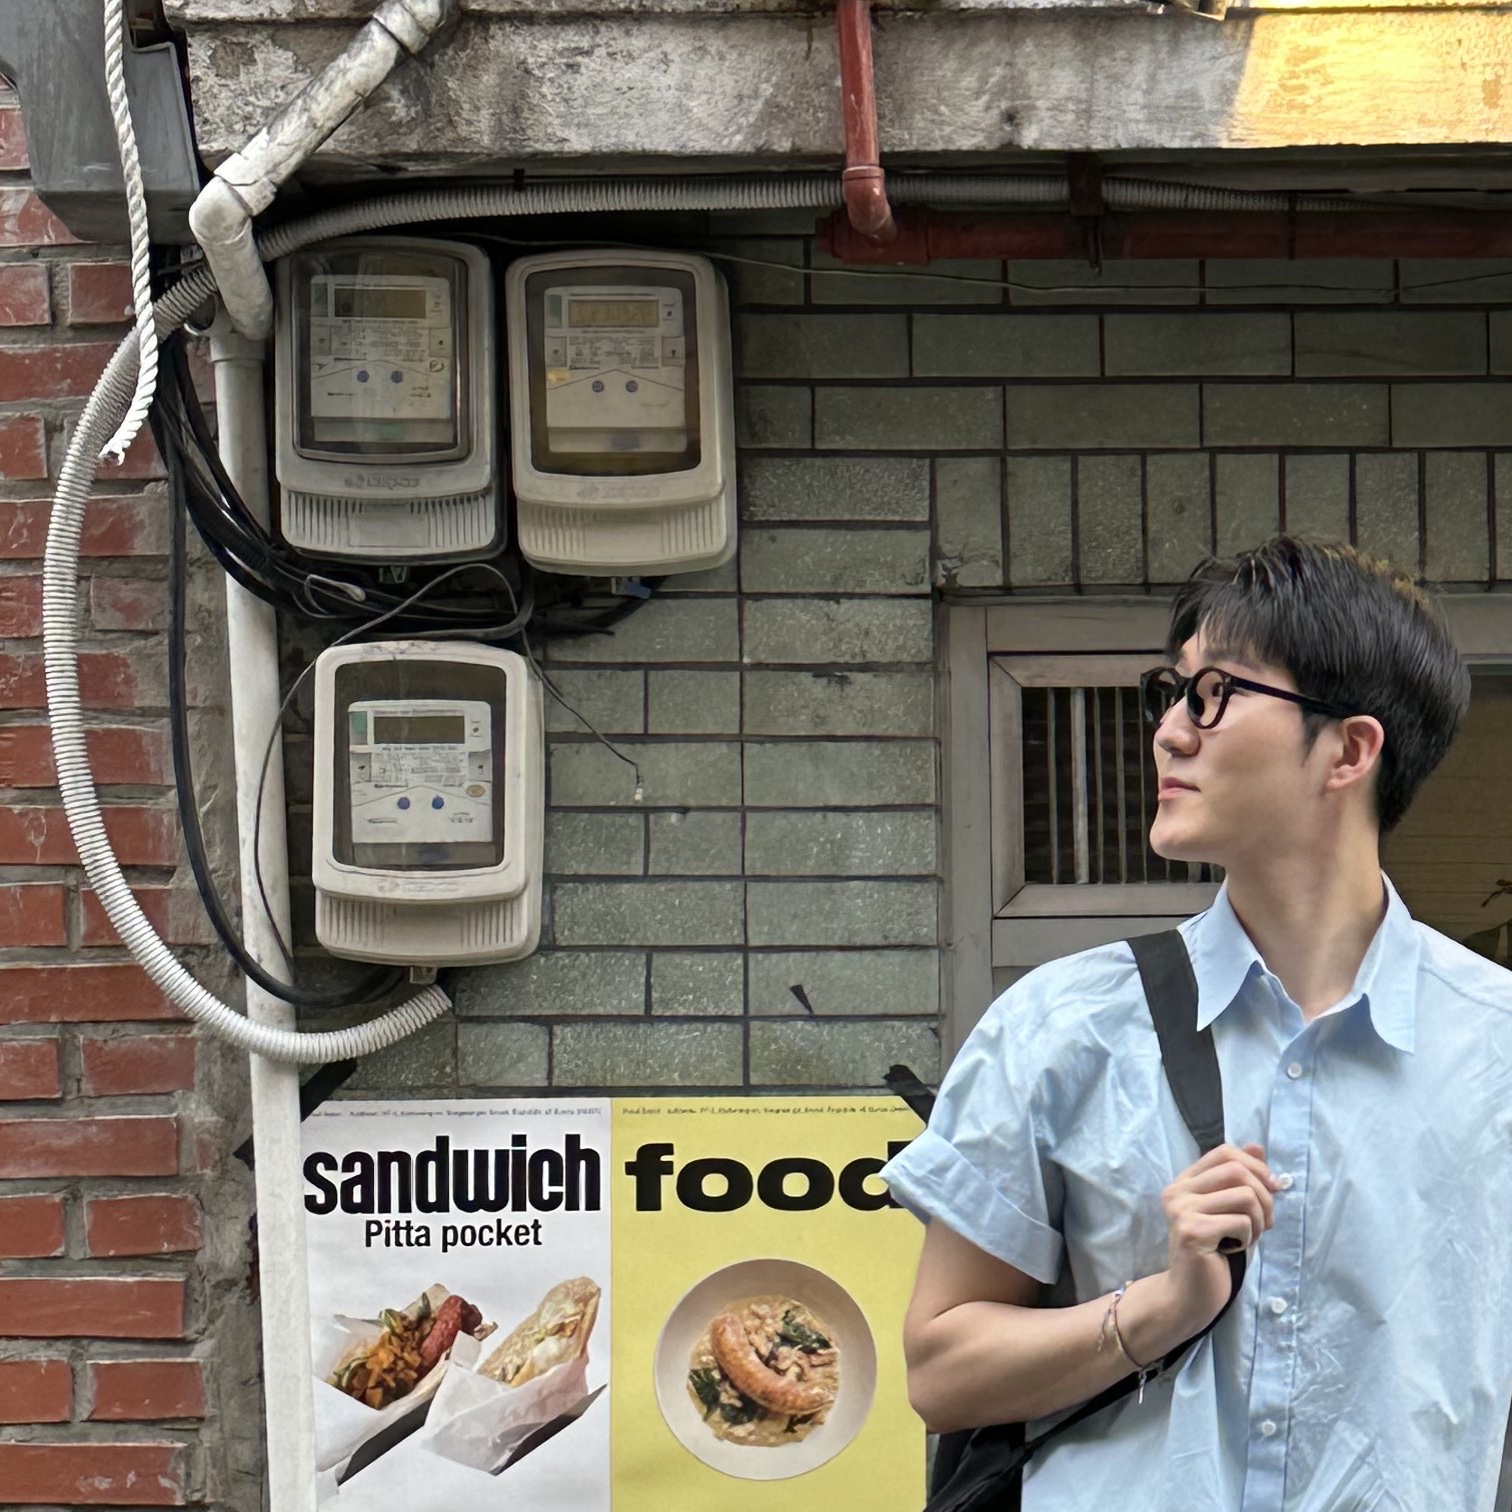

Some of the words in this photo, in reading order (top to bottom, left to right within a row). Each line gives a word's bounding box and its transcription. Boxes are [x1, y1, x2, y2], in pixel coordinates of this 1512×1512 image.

[302, 1133, 601, 1215] sandwich
[625, 1140, 915, 1212] food
[365, 1219, 431, 1247] Pitta
[442, 1218, 542, 1253] pocket
